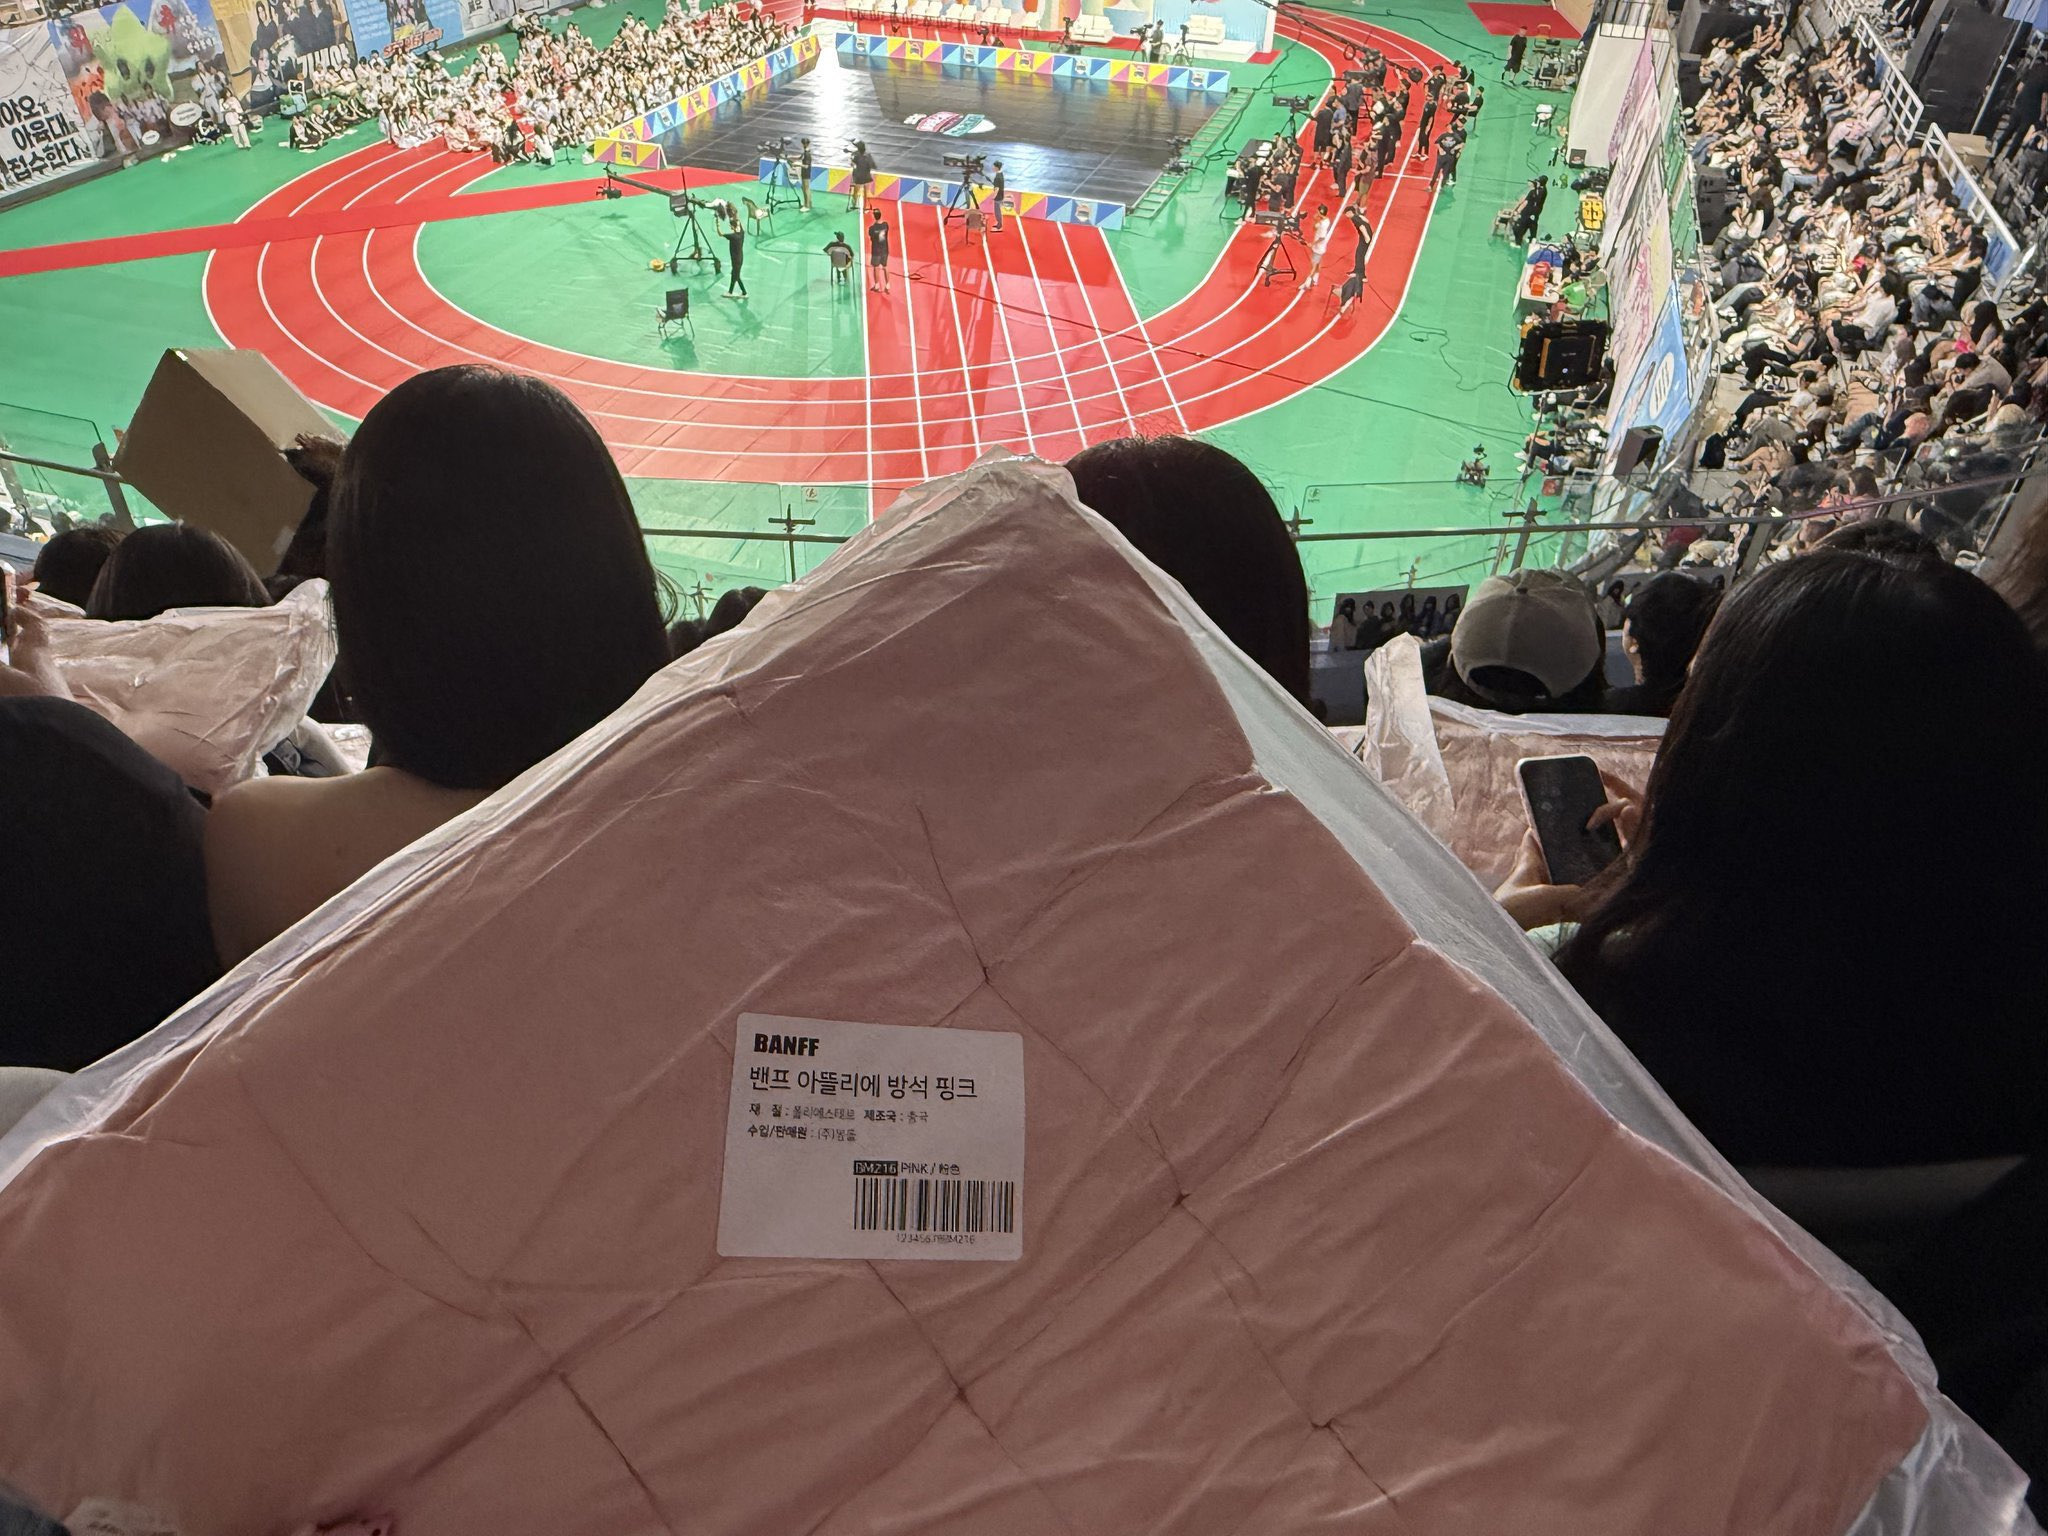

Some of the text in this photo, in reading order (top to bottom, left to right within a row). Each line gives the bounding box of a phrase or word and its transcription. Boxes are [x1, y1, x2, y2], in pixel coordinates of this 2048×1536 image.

[753, 1033, 820, 1057] BANFF
[750, 1067, 978, 1101] 밴프 아뜰리에 방석 핑크
[864, 1109, 896, 1123] 제조국
[854, 1161, 898, 1175] BM216
[901, 1162, 928, 1175] PINK
